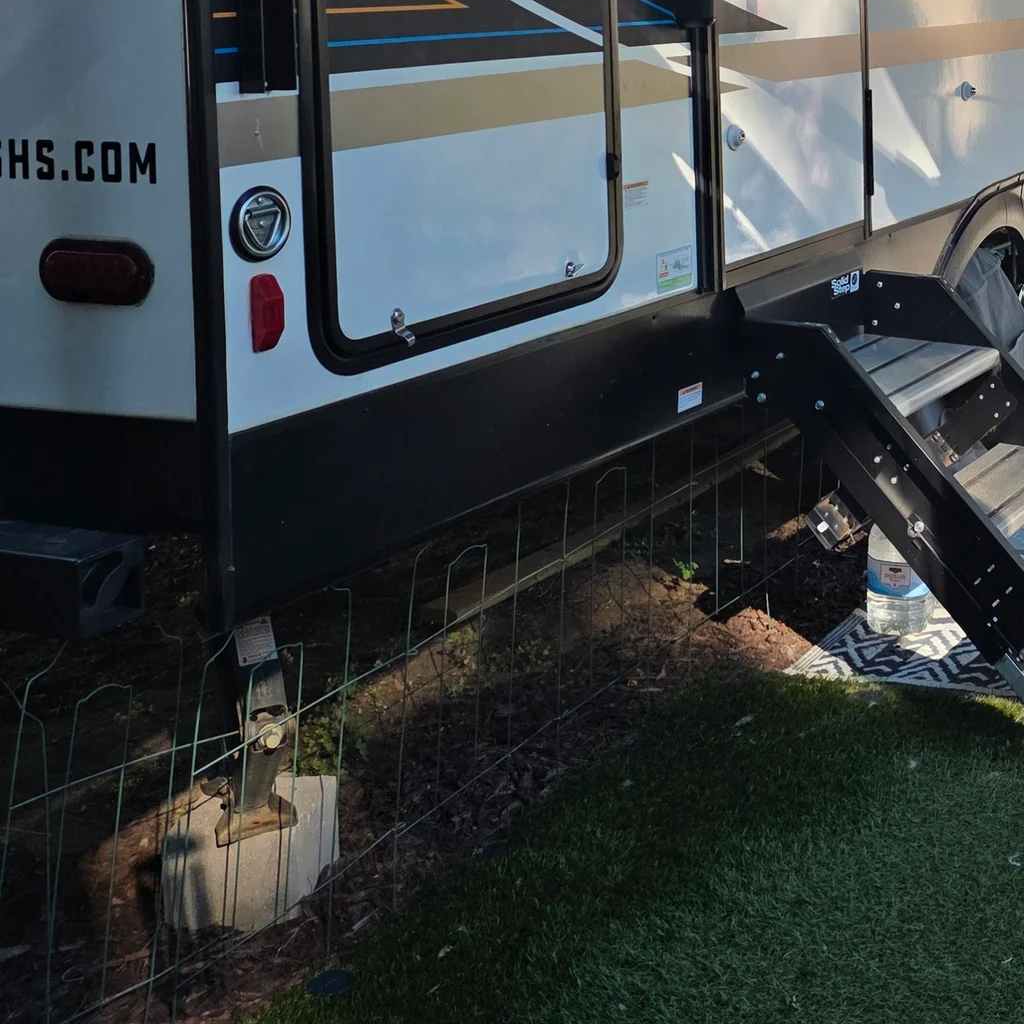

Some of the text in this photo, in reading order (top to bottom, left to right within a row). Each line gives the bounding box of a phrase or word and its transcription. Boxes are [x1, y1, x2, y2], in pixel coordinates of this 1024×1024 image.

[0, 138, 157, 185] HS.COM
[831, 274, 849, 289] Solid
[833, 283, 850, 296] Step
